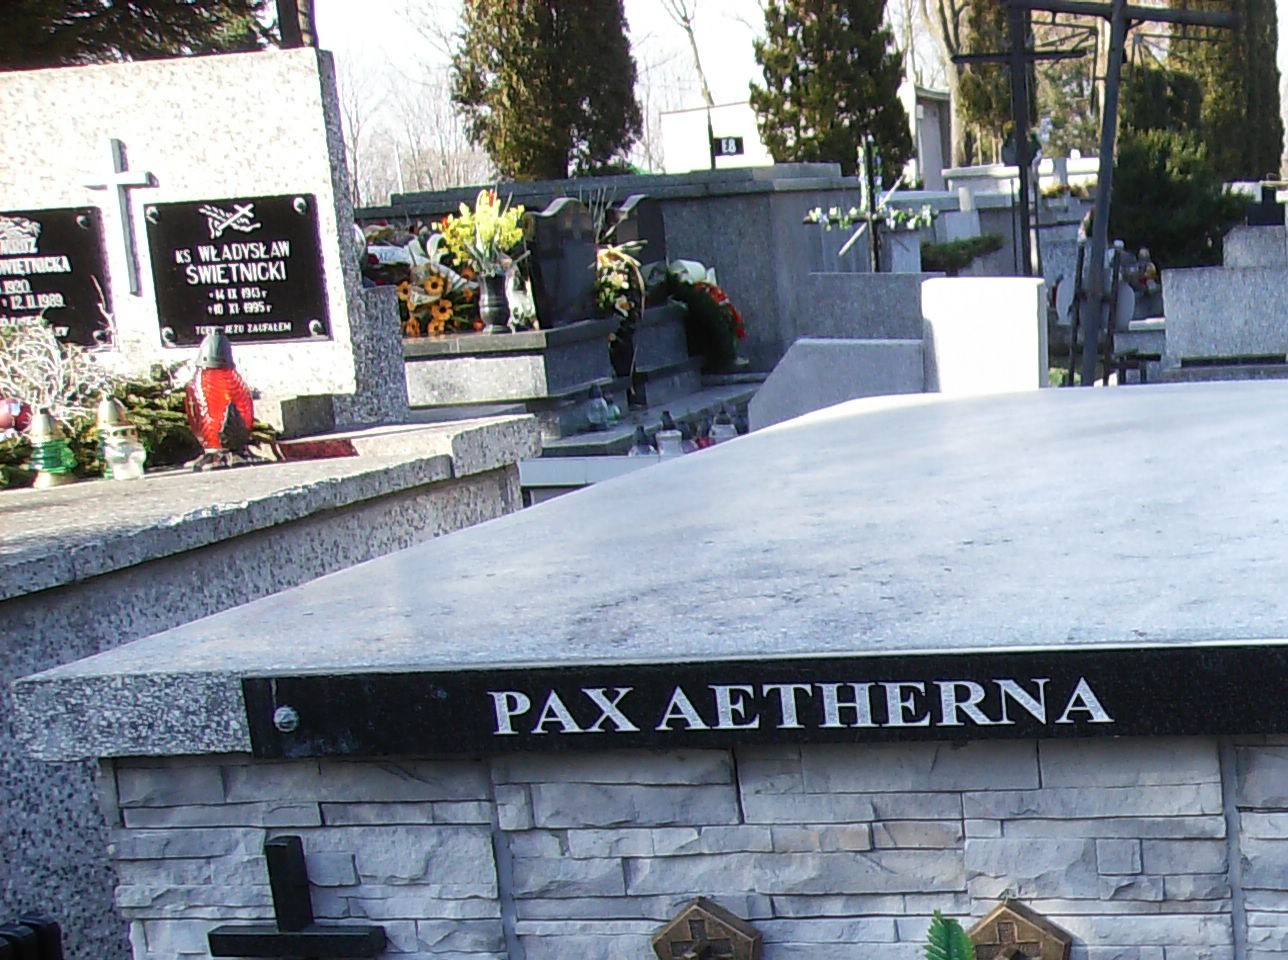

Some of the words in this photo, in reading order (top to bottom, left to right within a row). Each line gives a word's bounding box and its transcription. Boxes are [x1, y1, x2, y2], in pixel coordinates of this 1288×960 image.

[198, 240, 290, 262] WŁADYSŁAW
[487, 686, 640, 735] PAX
[655, 676, 1115, 731] AETHERNA
